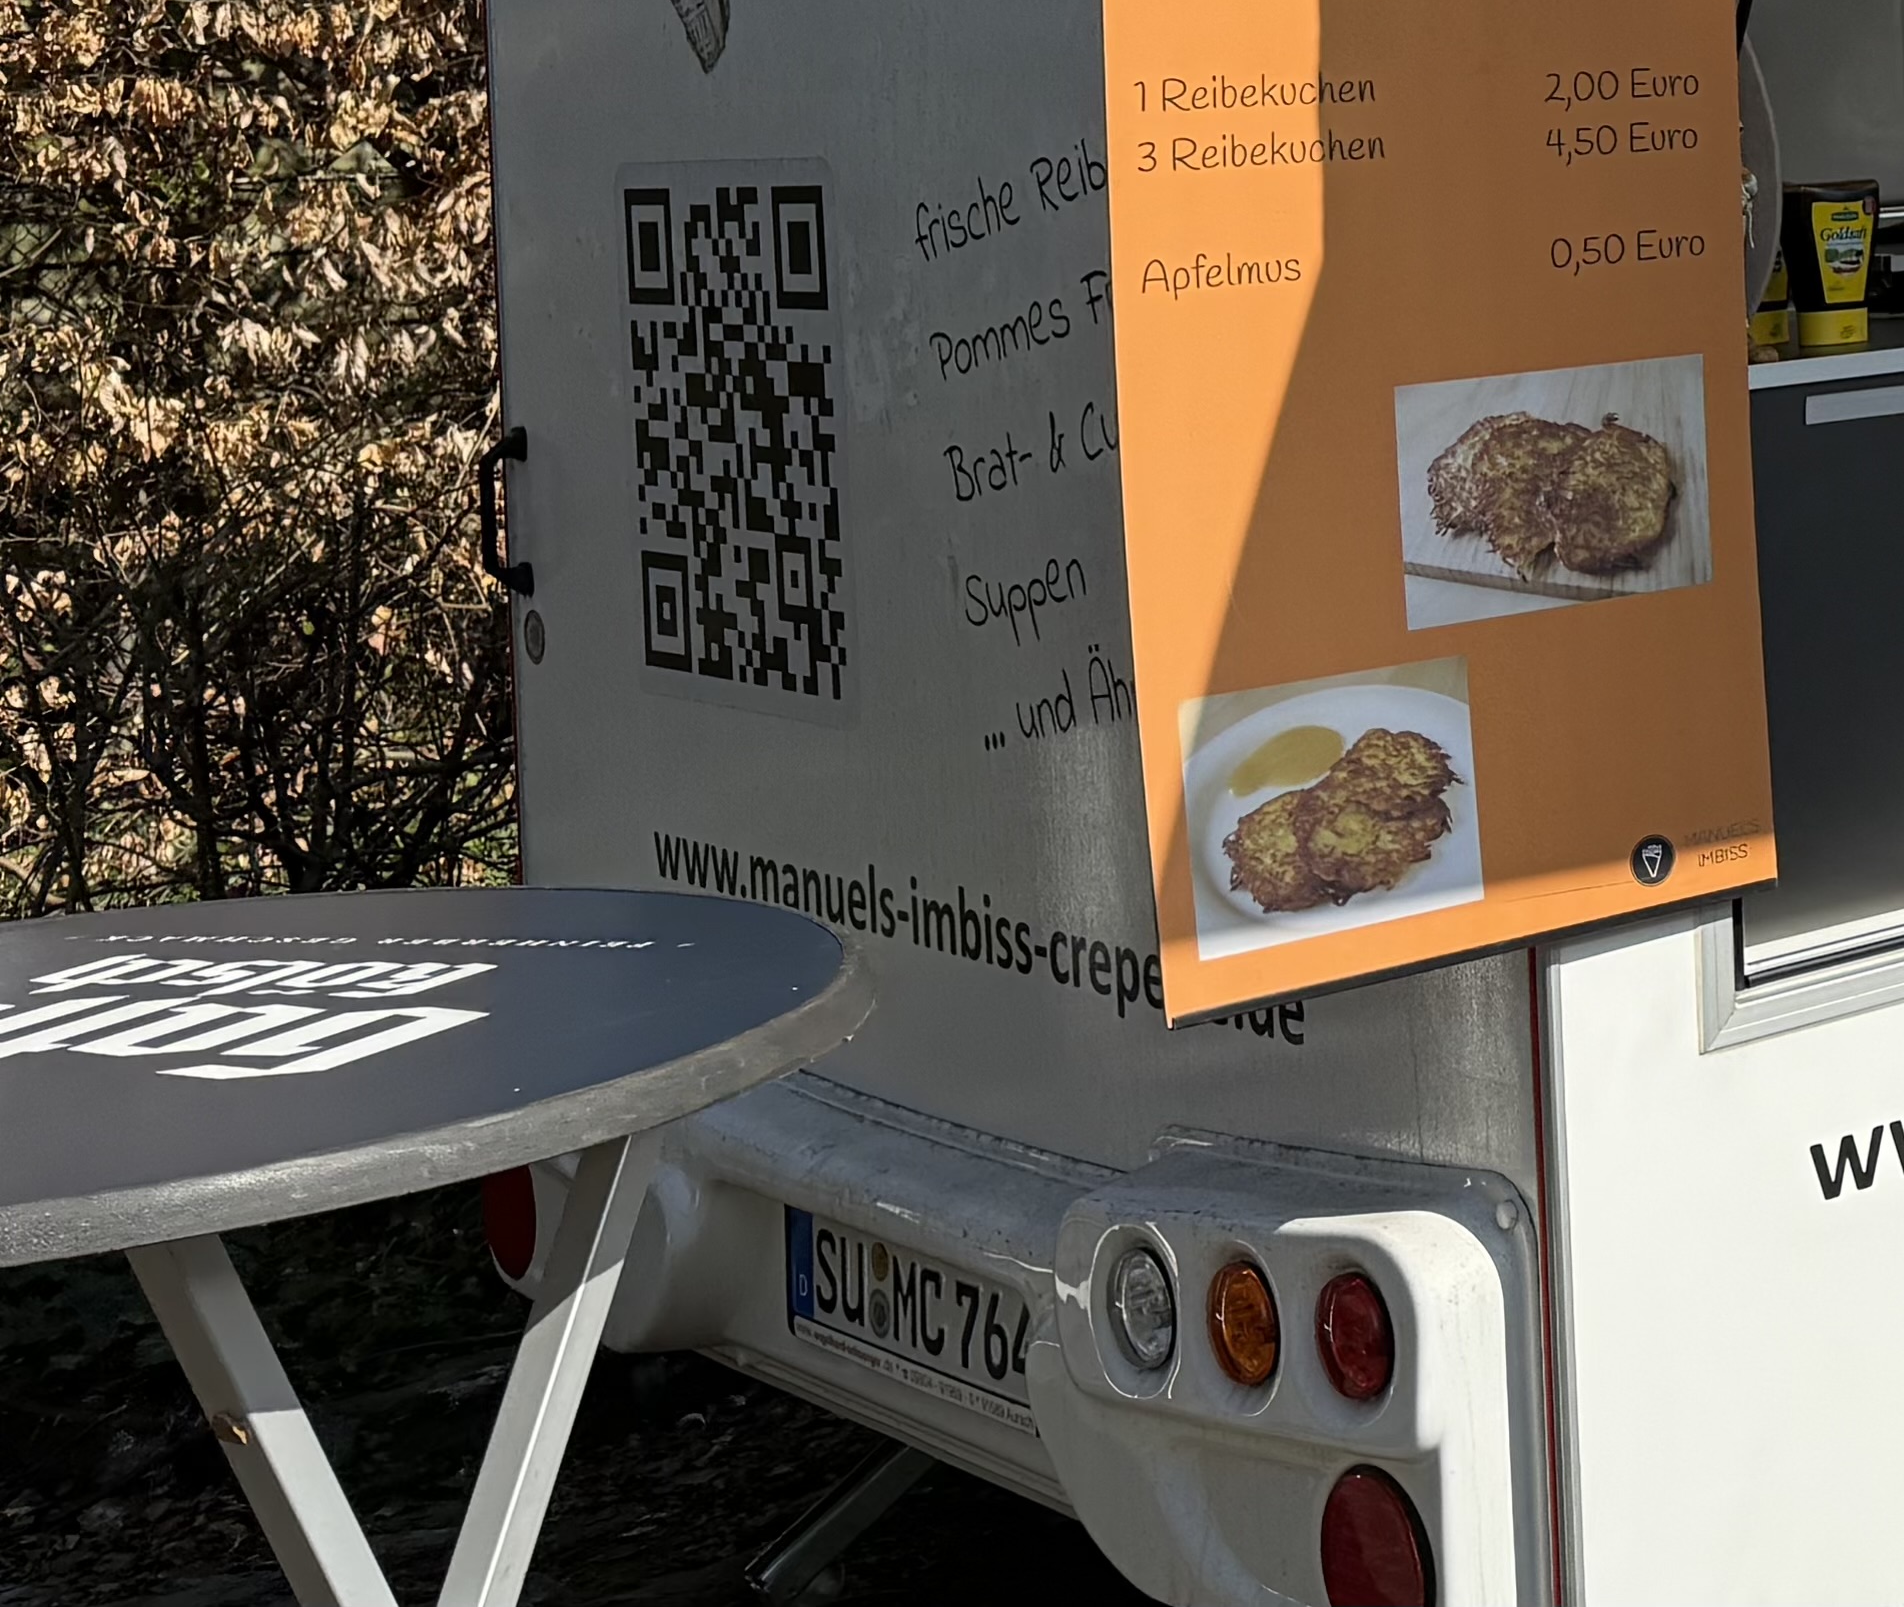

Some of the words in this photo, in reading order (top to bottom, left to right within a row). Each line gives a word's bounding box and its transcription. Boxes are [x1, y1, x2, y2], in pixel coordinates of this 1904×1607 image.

[1133, 79, 1147, 112] 1
[1162, 71, 1376, 112] Reibekuchen
[1545, 71, 1619, 113] 2,00
[1631, 68, 1699, 100] Euro
[1136, 141, 1158, 173] 3
[1172, 130, 1386, 171] Reibekuchen
[1546, 124, 1618, 166] 4,50
[1629, 123, 1698, 154] Euro
[914, 177, 1020, 262] frische
[1142, 254, 1302, 301] Apfelmus
[1551, 233, 1625, 276] 0,50
[1636, 229, 1705, 263] Euro
[929, 297, 1071, 382] Pommes
[943, 444, 1033, 503] Brat-
[1048, 411, 1066, 473] &
[965, 556, 1087, 646] Suppen
[1017, 689, 1075, 742] und
[1698, 844, 1749, 867] IMBISS
[799, 1274, 808, 1297] D
[816, 1228, 864, 1327] SU
[892, 1255, 945, 1357] MC
